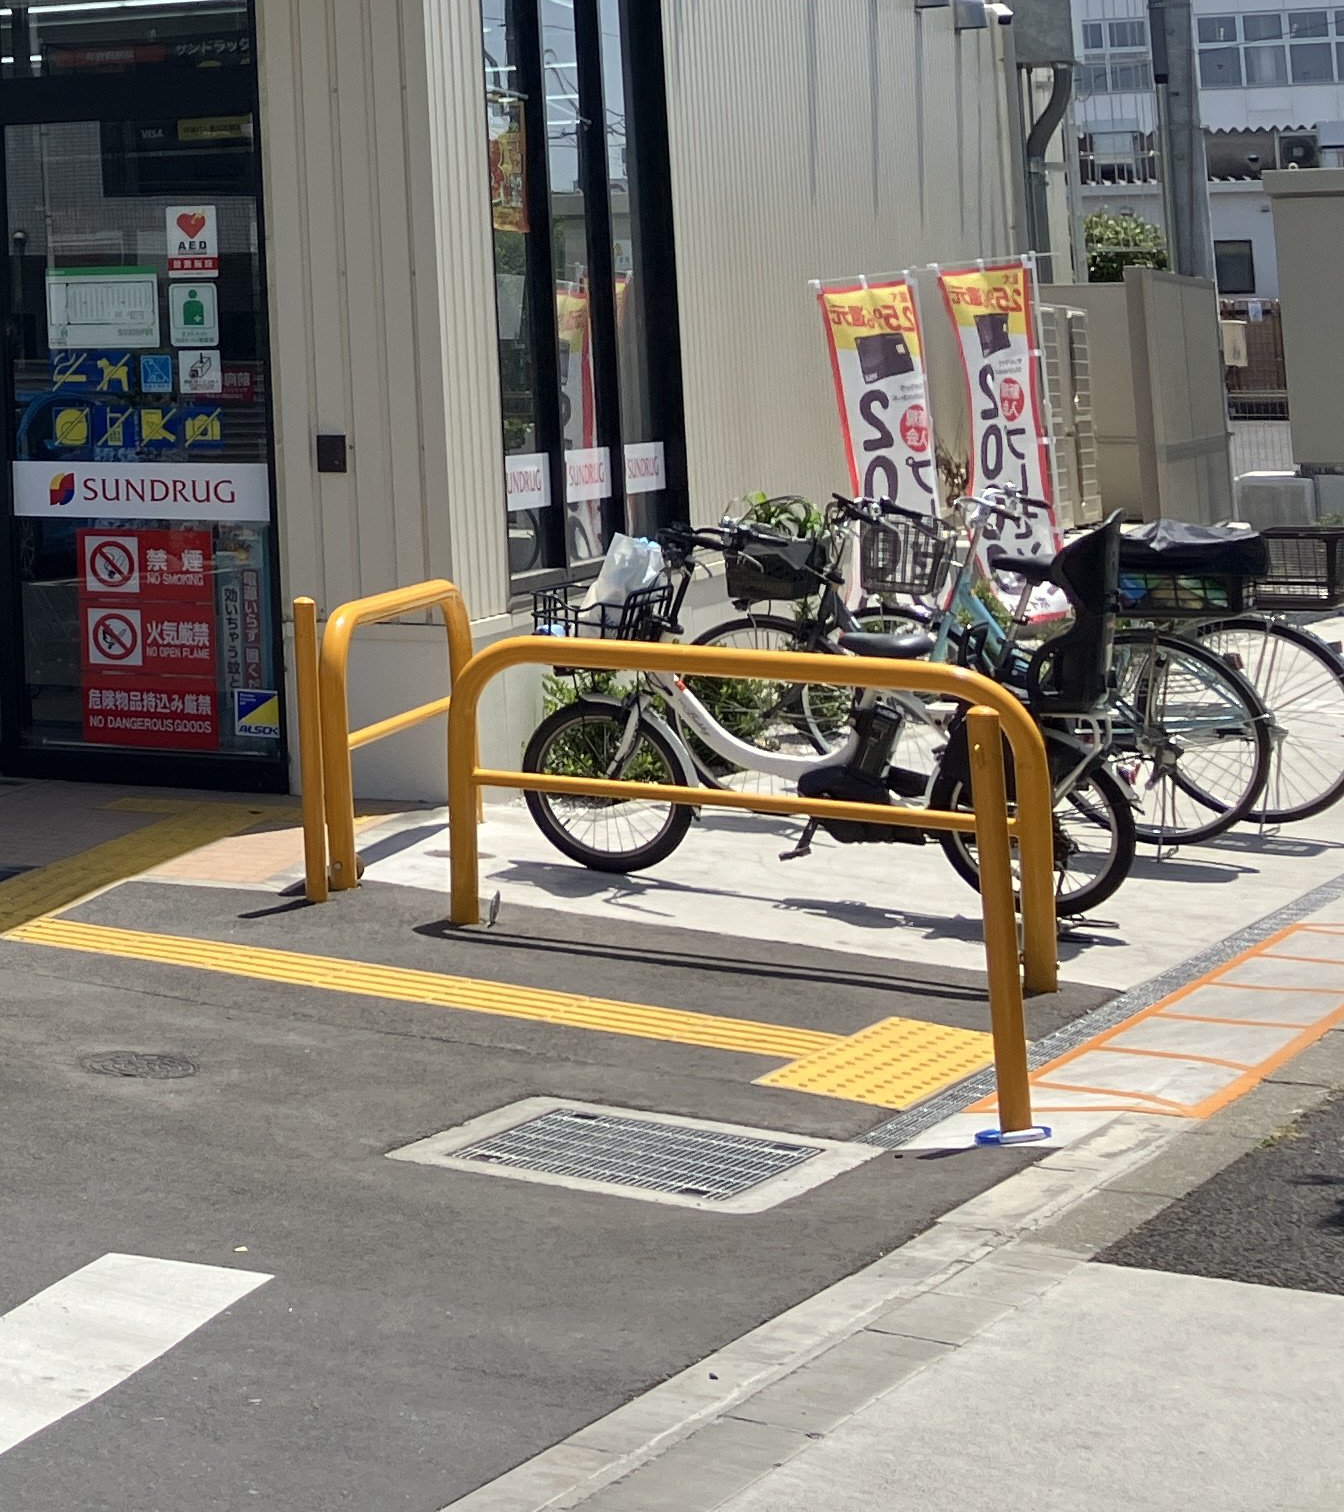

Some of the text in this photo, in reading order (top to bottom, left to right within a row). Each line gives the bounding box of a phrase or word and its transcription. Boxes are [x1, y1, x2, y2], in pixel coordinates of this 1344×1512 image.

[178, 240, 207, 250] AED
[568, 460, 605, 489] SUNDRUG
[627, 453, 660, 480] SUNDRUG
[82, 476, 236, 504] SUNDRUG
[506, 468, 542, 496] UNDRUG
[145, 548, 204, 571] 禁煙
[146, 572, 204, 586] NO SMOKING
[145, 620, 210, 647] 火気厳禁
[224, 588, 242, 692] 効いちゃう蚊と
[146, 645, 210, 660] NO OPEN FLAME
[88, 688, 212, 716] 危険物品持込み厳禁
[89, 716, 212, 732] NO DANGEROUS GOODS
